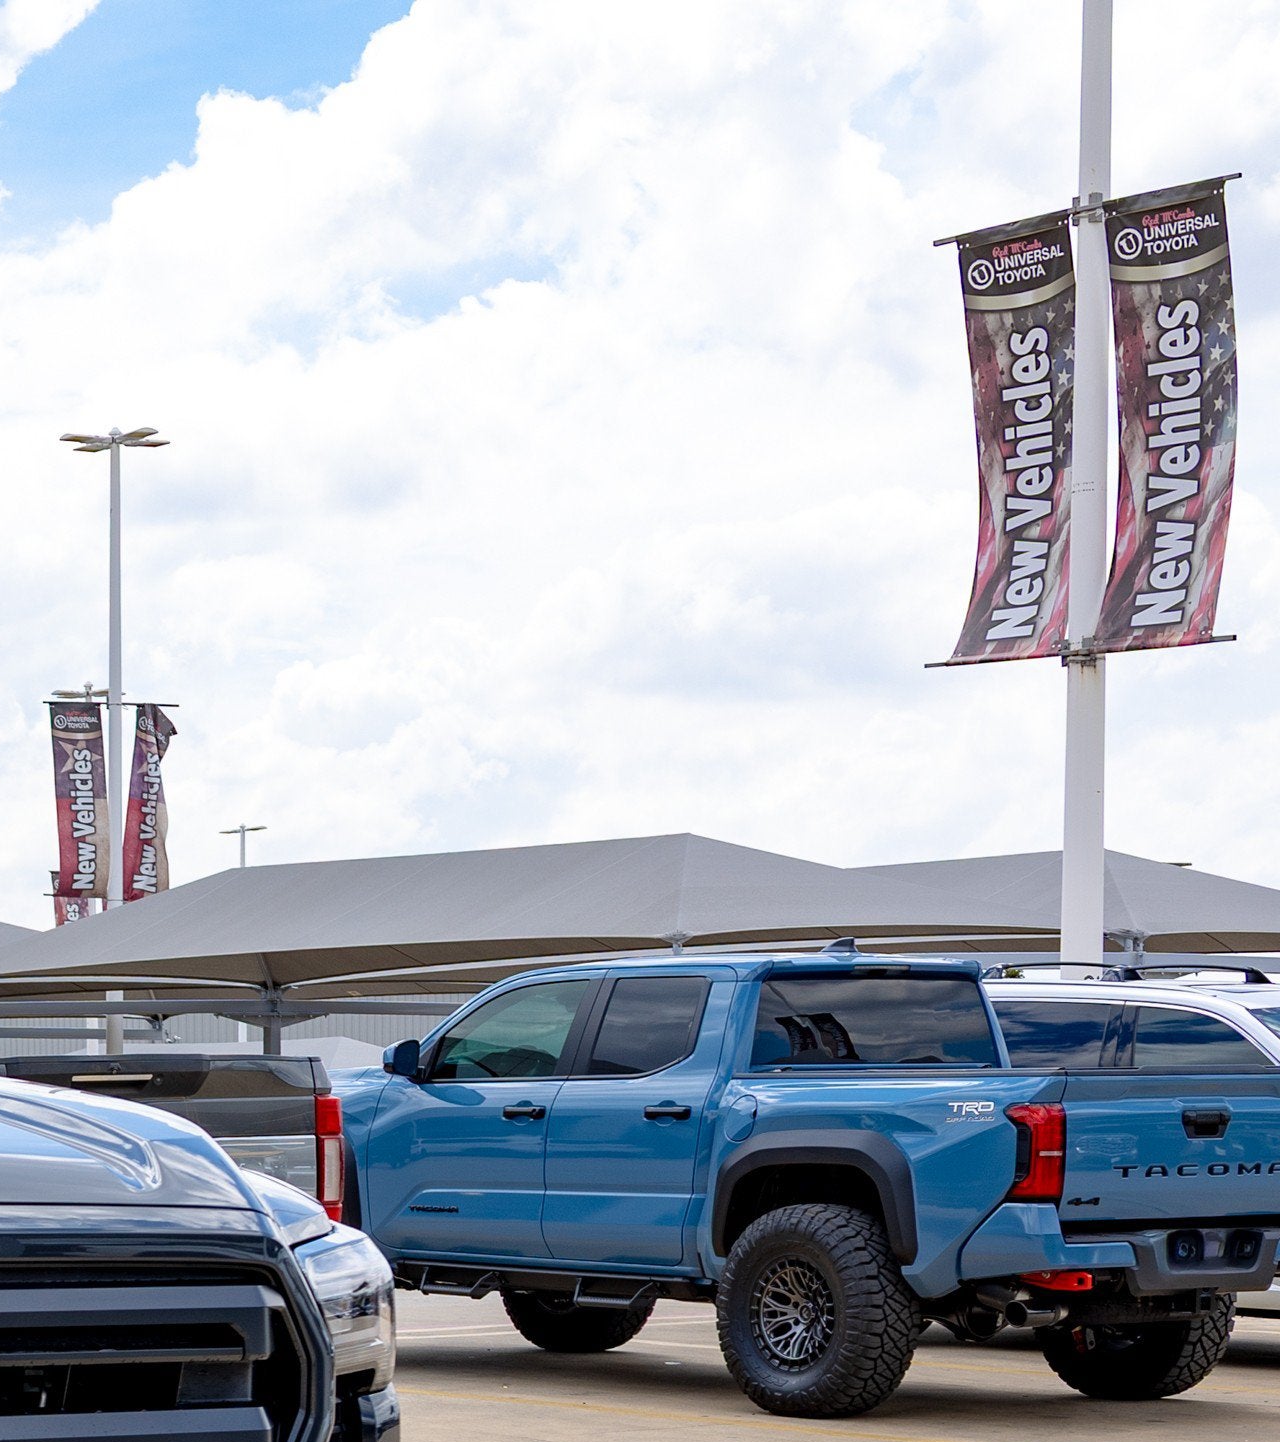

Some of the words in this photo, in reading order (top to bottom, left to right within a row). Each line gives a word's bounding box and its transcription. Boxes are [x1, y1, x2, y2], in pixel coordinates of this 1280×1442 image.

[1143, 213, 1219, 240] UNIVERSAL
[1145, 233, 1198, 256] TOYOTA
[994, 244, 1065, 272] UNIVERSAL
[996, 264, 1046, 286] TOYOTA
[1147, 299, 1200, 511] Vehicles
[1003, 328, 1053, 532] Vehicles
[986, 539, 1049, 641] New
[1131, 521, 1195, 627] New
[67, 716, 98, 724] UNIVERSAL
[70, 749, 96, 838] Vehicles
[140, 752, 159, 840] Vehicles
[72, 842, 96, 890] New
[133, 844, 157, 893] New
[948, 1102, 995, 1115] TRD
[1113, 1162, 1280, 1178] TACOMA
